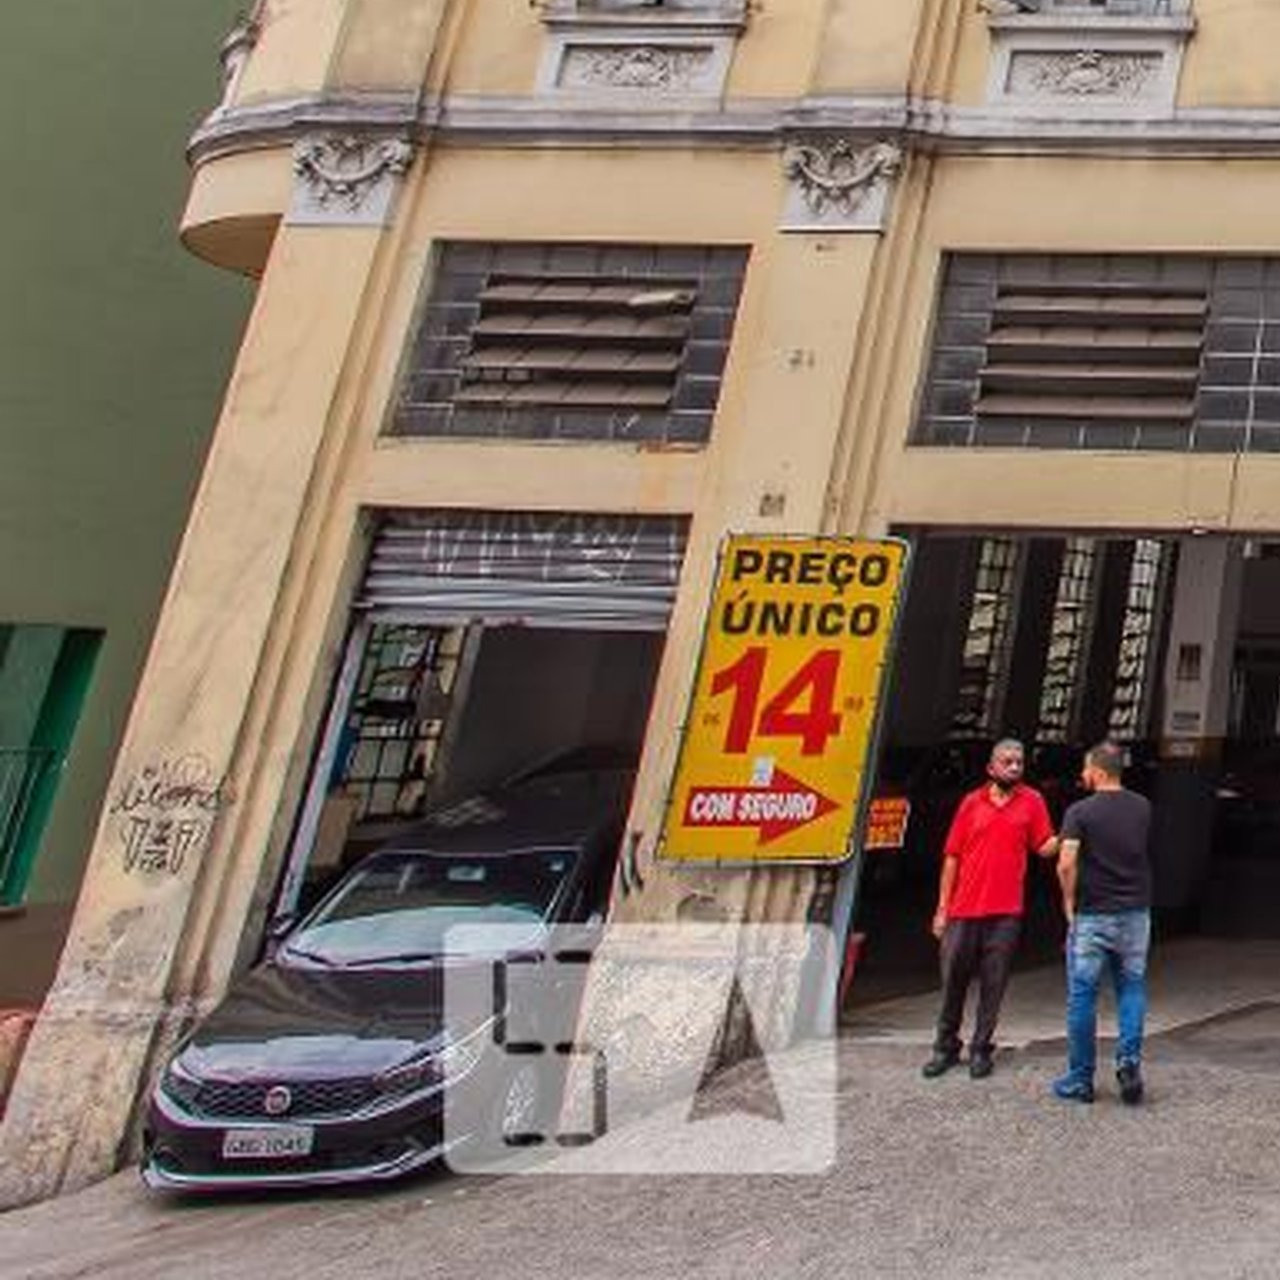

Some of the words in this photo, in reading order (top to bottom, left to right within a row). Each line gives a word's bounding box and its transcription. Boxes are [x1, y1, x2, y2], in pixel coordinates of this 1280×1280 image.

[733, 550, 890, 594] PREÇO
[721, 590, 881, 637] ÚNICO
[710, 646, 842, 756] 14
[690, 793, 736, 821] COM
[738, 793, 817, 821] SEGURO
